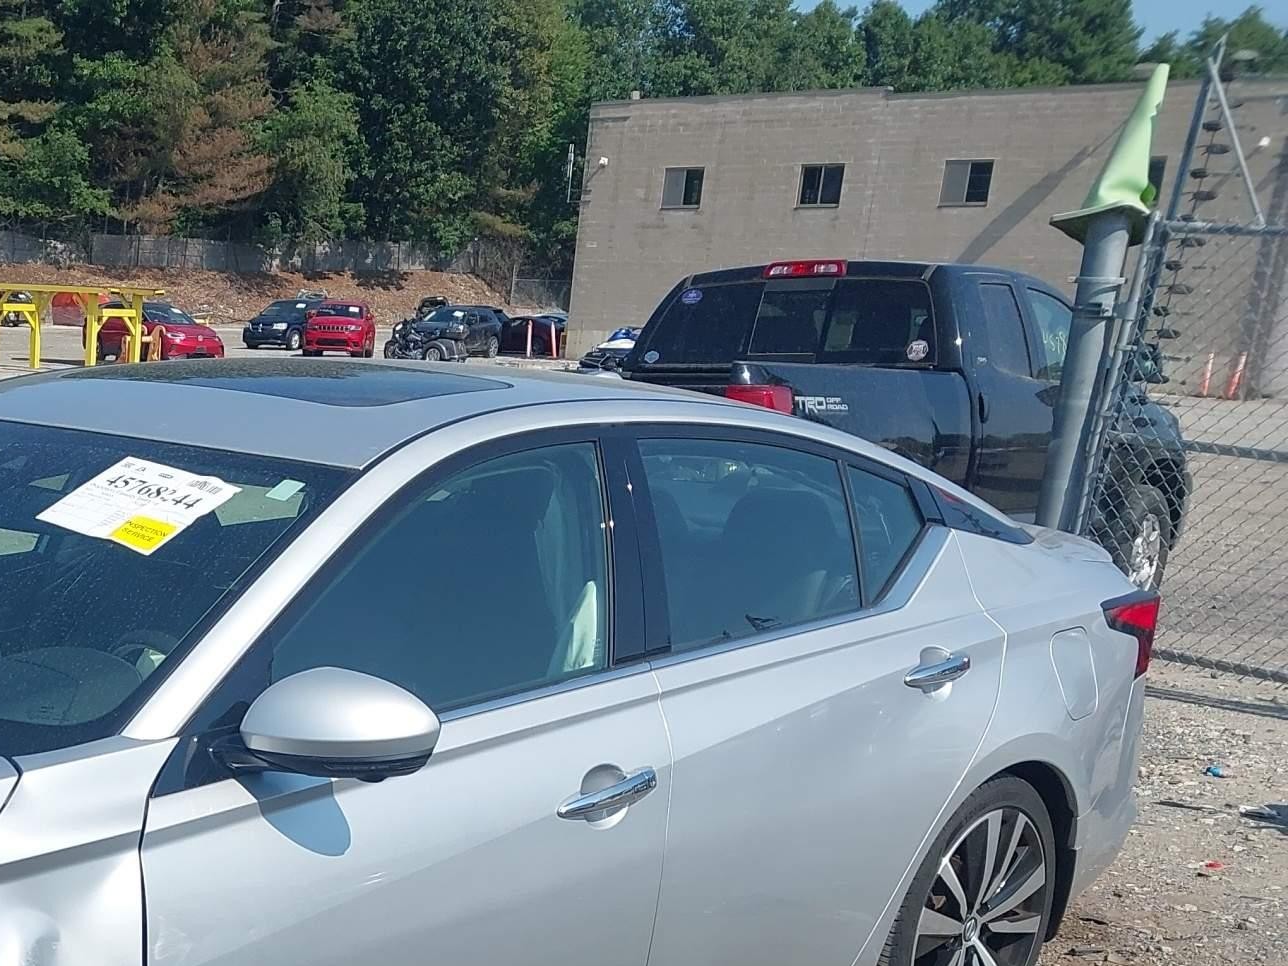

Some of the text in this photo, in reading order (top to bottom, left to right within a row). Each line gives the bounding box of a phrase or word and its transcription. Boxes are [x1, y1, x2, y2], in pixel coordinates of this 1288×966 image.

[795, 396, 826, 414] TRD
[106, 474, 203, 509] 45768244
[122, 527, 154, 543] SERVICE
[125, 519, 168, 538] INSPECTION
